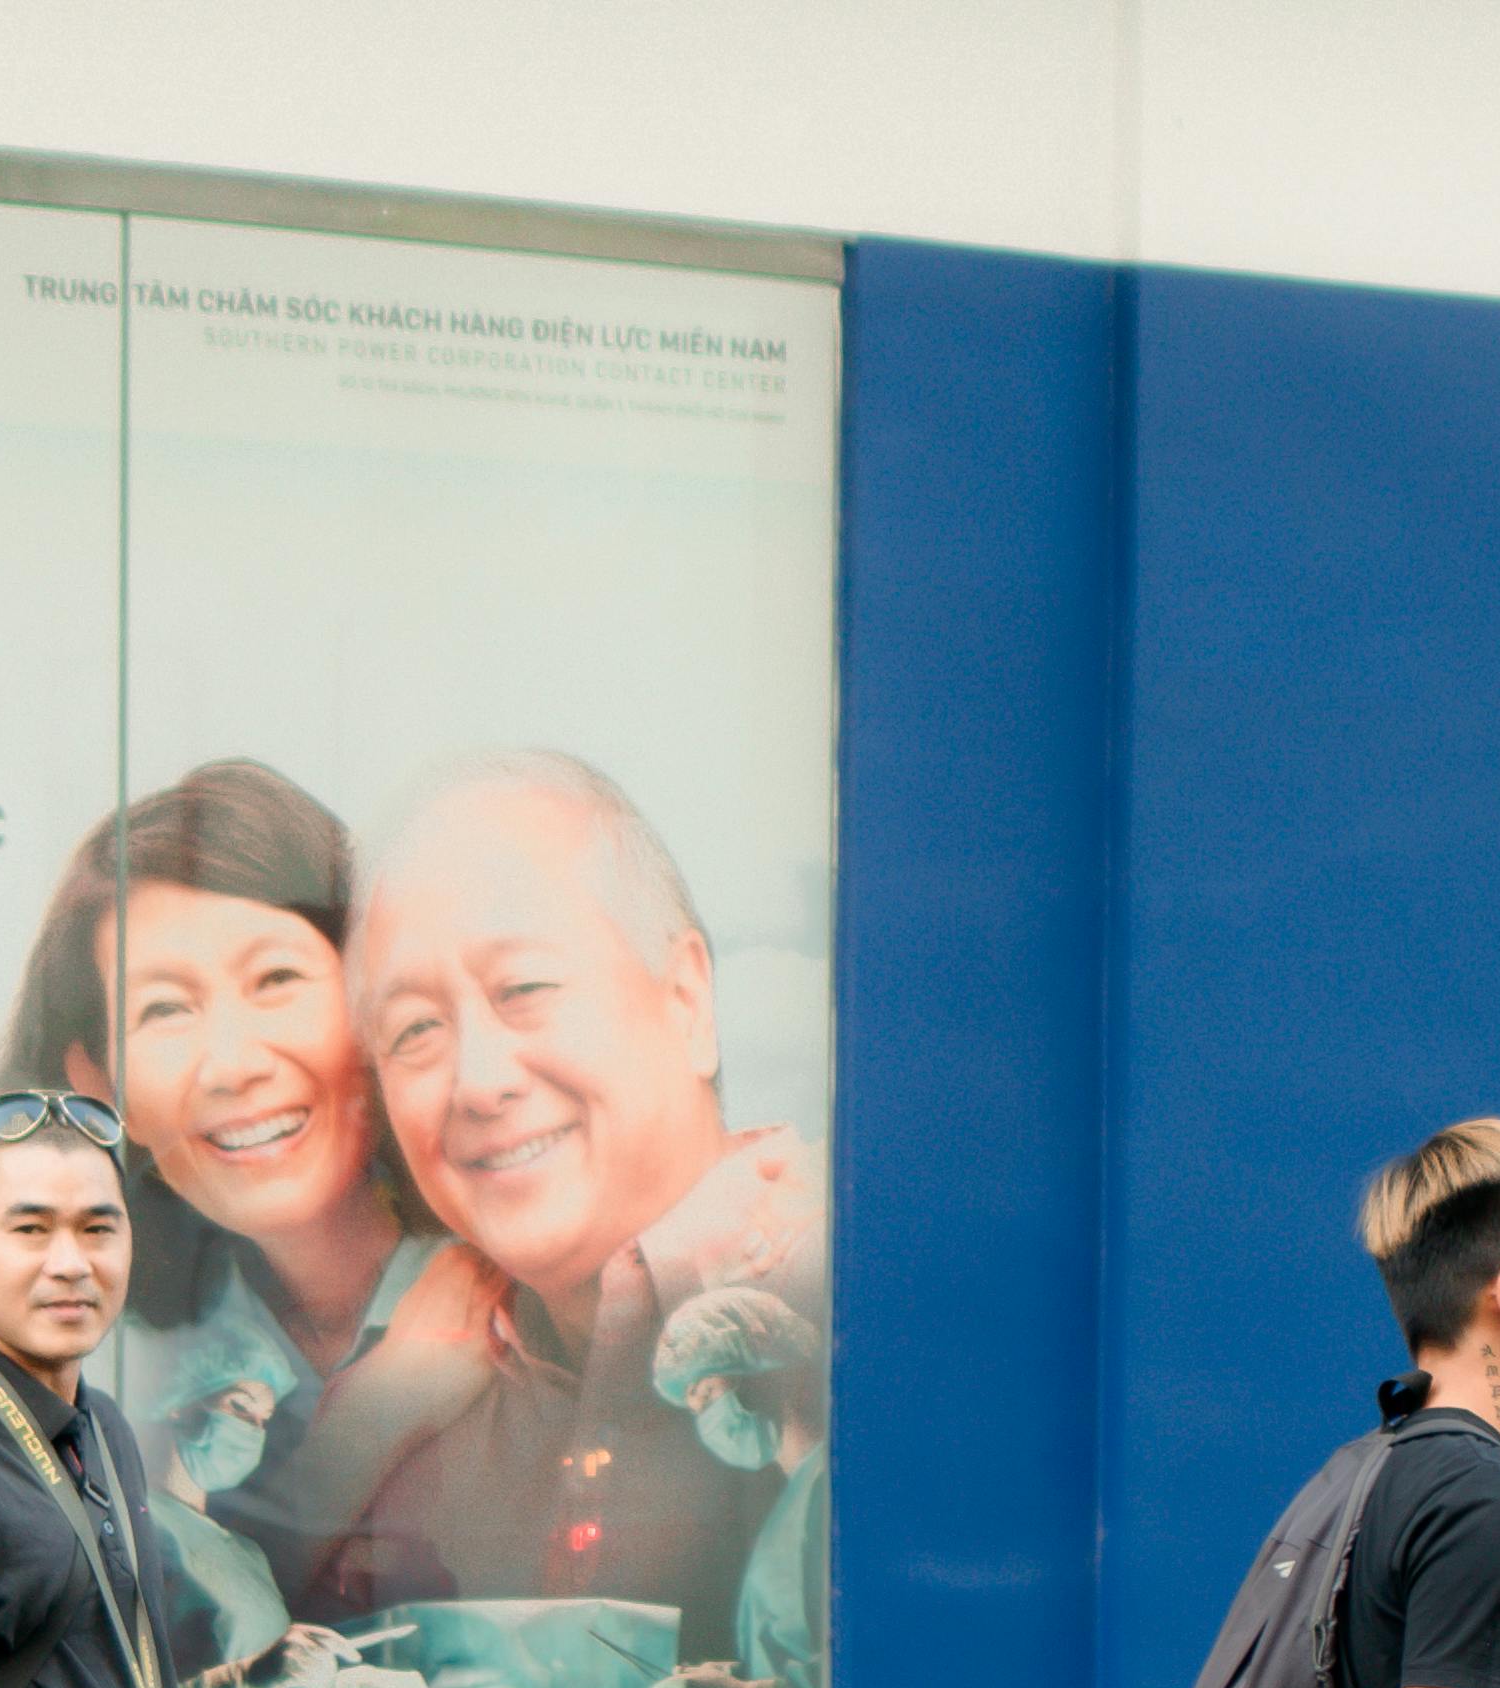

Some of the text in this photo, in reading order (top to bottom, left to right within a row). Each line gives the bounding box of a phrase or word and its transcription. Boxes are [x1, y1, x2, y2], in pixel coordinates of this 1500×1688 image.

[23, 273, 787, 362] TRUNG TÂM CHĂM SÓC KHÁCH HÀNG ĐIỆN LỰC MIỀN NAM
[202, 326, 787, 394] SOUTHERN POWER CORPORATION CONTACT CENTER
